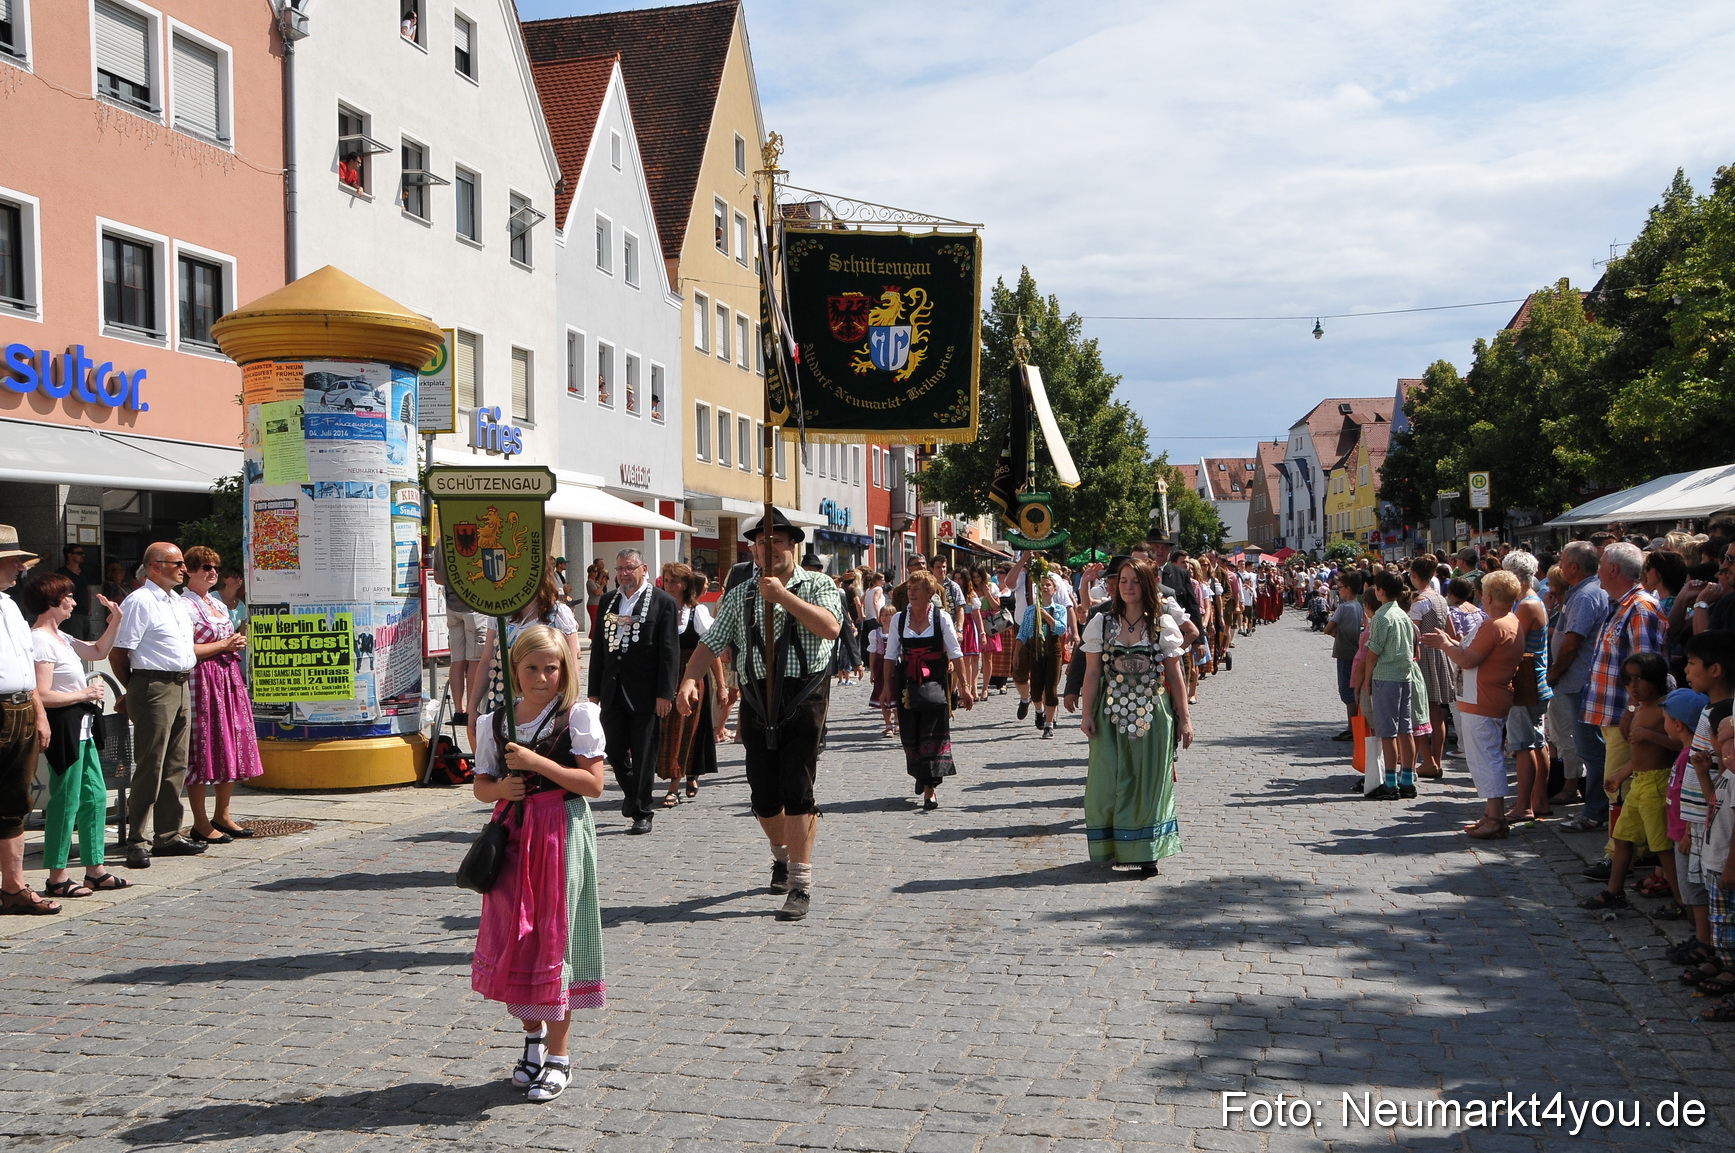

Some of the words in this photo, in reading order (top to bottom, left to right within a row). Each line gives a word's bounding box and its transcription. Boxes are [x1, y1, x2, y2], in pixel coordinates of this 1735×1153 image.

[828, 253, 931, 280] Schützengau
[477, 406, 522, 454] fries
[437, 475, 541, 490] SCHÜTZENGAU
[444, 531, 540, 610] ALTDORF-NEUMARKT-BEILNGRIES
[254, 621, 272, 634] New
[277, 620, 313, 633] Berlin
[254, 635, 348, 650] Volksfest
[274, 669, 301, 677] SAMSTAGS
